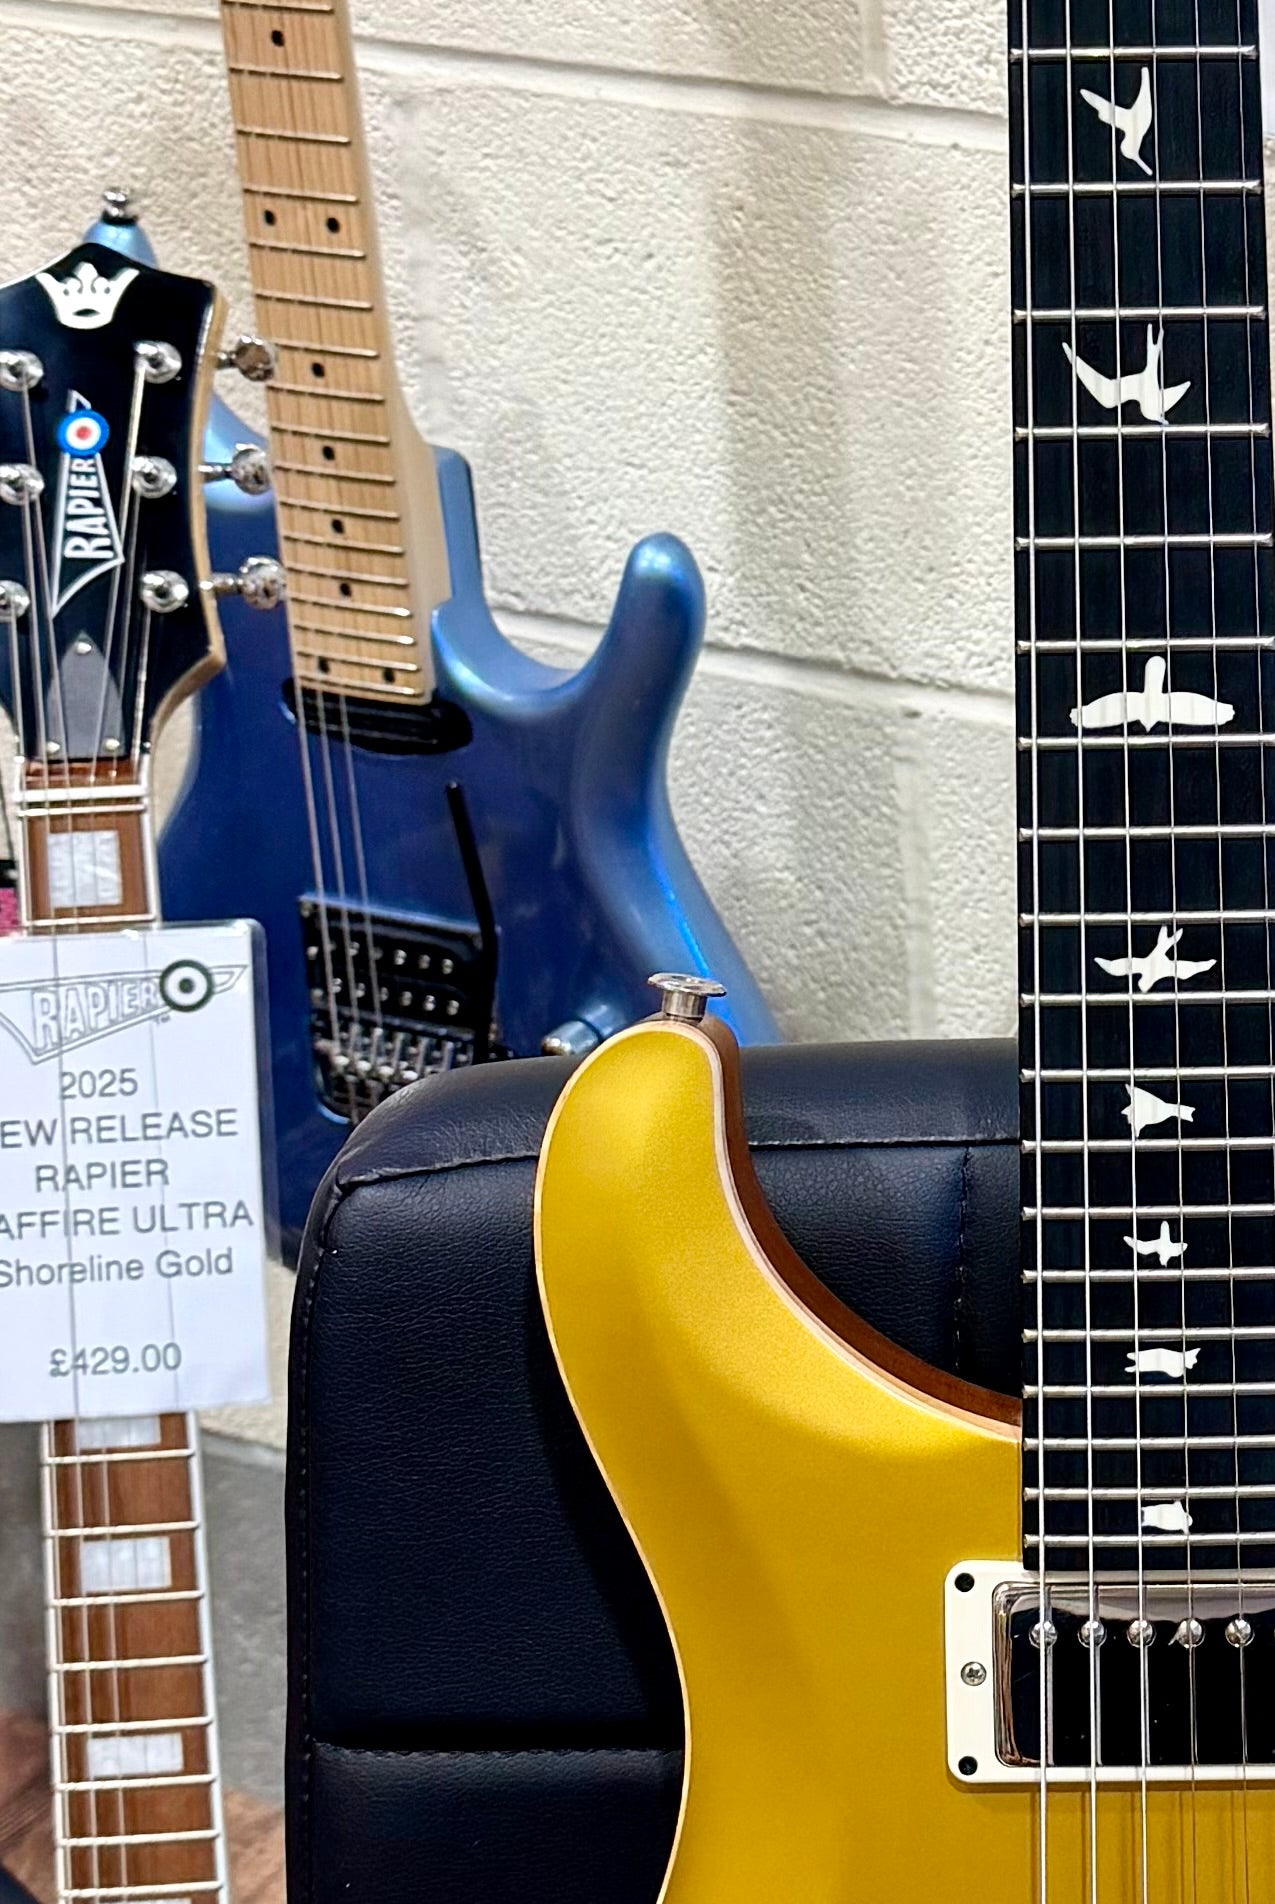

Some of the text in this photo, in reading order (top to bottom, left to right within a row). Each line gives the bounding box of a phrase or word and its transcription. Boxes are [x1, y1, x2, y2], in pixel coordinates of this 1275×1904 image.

[64, 458, 114, 559] RAPIER
[31, 976, 164, 1053] RAPIER
[60, 1068, 139, 1100] 2025
[0, 1108, 239, 1148] EW RELEASE
[35, 1158, 170, 1193] RAPIER
[0, 1200, 254, 1241] AFFIRE ULTRA
[0, 1247, 233, 1288] Shoreline Gold
[49, 1342, 182, 1377] £429.00
